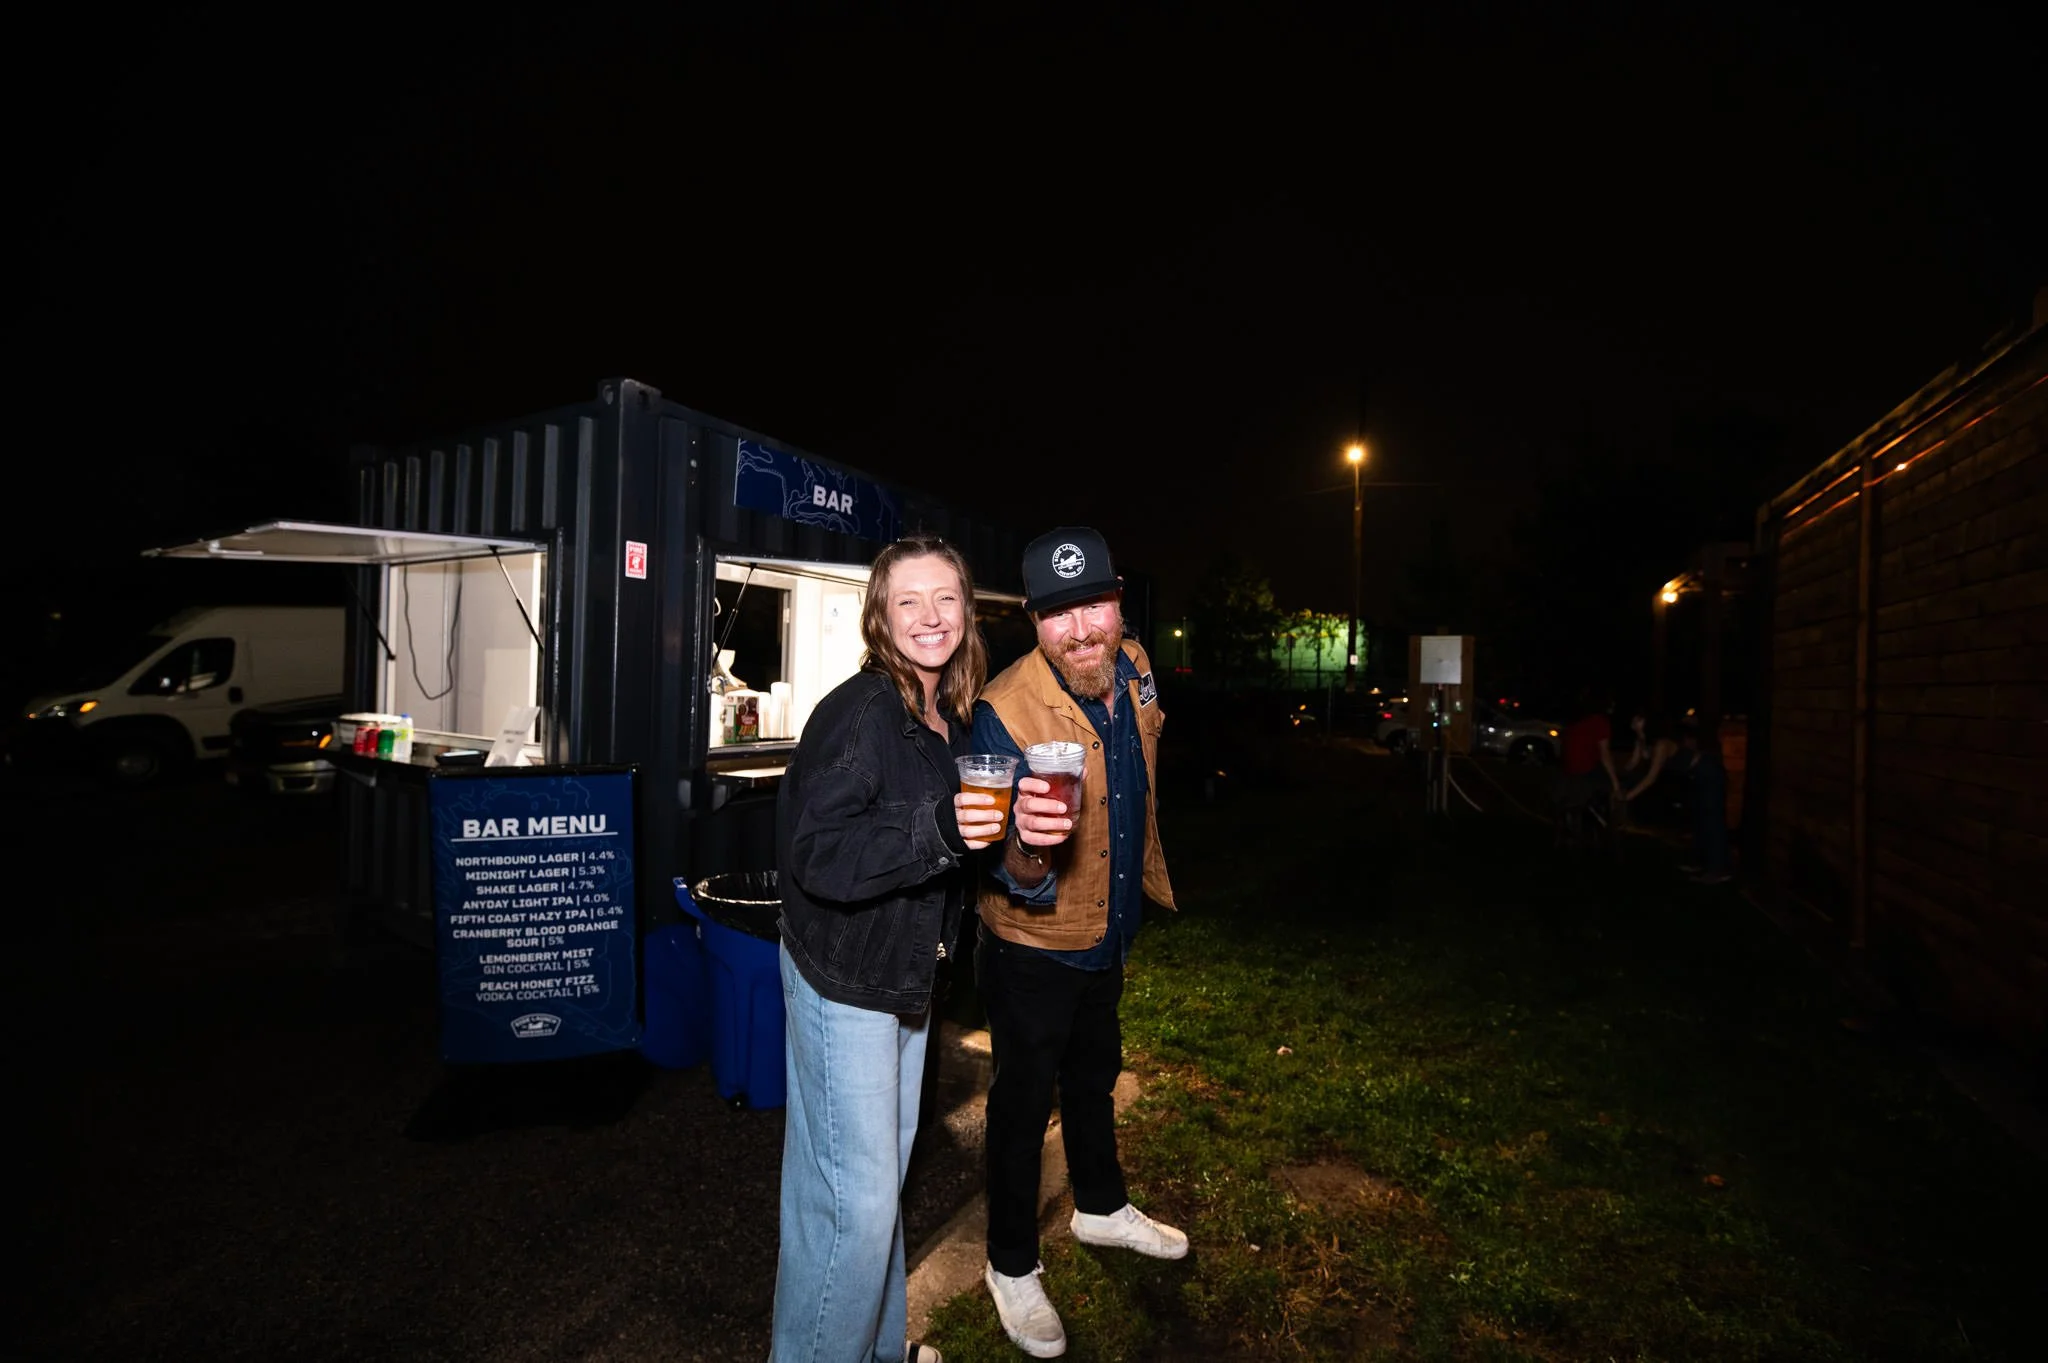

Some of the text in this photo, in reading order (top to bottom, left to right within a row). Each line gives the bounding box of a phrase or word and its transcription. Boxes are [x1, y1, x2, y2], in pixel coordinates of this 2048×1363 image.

[813, 485, 853, 515] BAR
[463, 814, 606, 838] BAR MENU
[456, 855, 536, 866] NORTHBOUND
[539, 853, 579, 864] LAGER
[588, 851, 615, 860] 4.4%
[465, 870, 527, 880] MIDNIGHT
[530, 867, 569, 878] LAGER
[578, 866, 605, 875] 5.3%
[476, 884, 516, 895] SHAKE
[519, 883, 558, 893] LAGER
[567, 881, 594, 890] 4.7%
[463, 900, 510, 910] ANYDAY
[512, 898, 549, 908] LIGHT
[552, 896, 573, 906] IPA
[582, 893, 610, 903] 4.0%
[450, 914, 485, 924] FIFTH
[488, 913, 527, 923] COAST
[529, 911, 562, 922] HAZY
[565, 909, 587, 919] IPA
[596, 906, 623, 916] 6.4%
[453, 920, 618, 938] CRANBERRY BLOOD ORANGE
[506, 938, 539, 948] SOUR
[548, 936, 564, 945] 5%
[479, 948, 594, 964] LEMONBERRY MIST
[483, 964, 505, 974] GIN
[507, 961, 564, 974] COCKTAIL
[574, 959, 590, 969] 5%
[480, 974, 595, 991] PEACH HONEY FIZZ
[476, 991, 513, 1001] VODKA
[516, 988, 574, 1000] COCKTAIL
[583, 984, 599, 994] 5%
